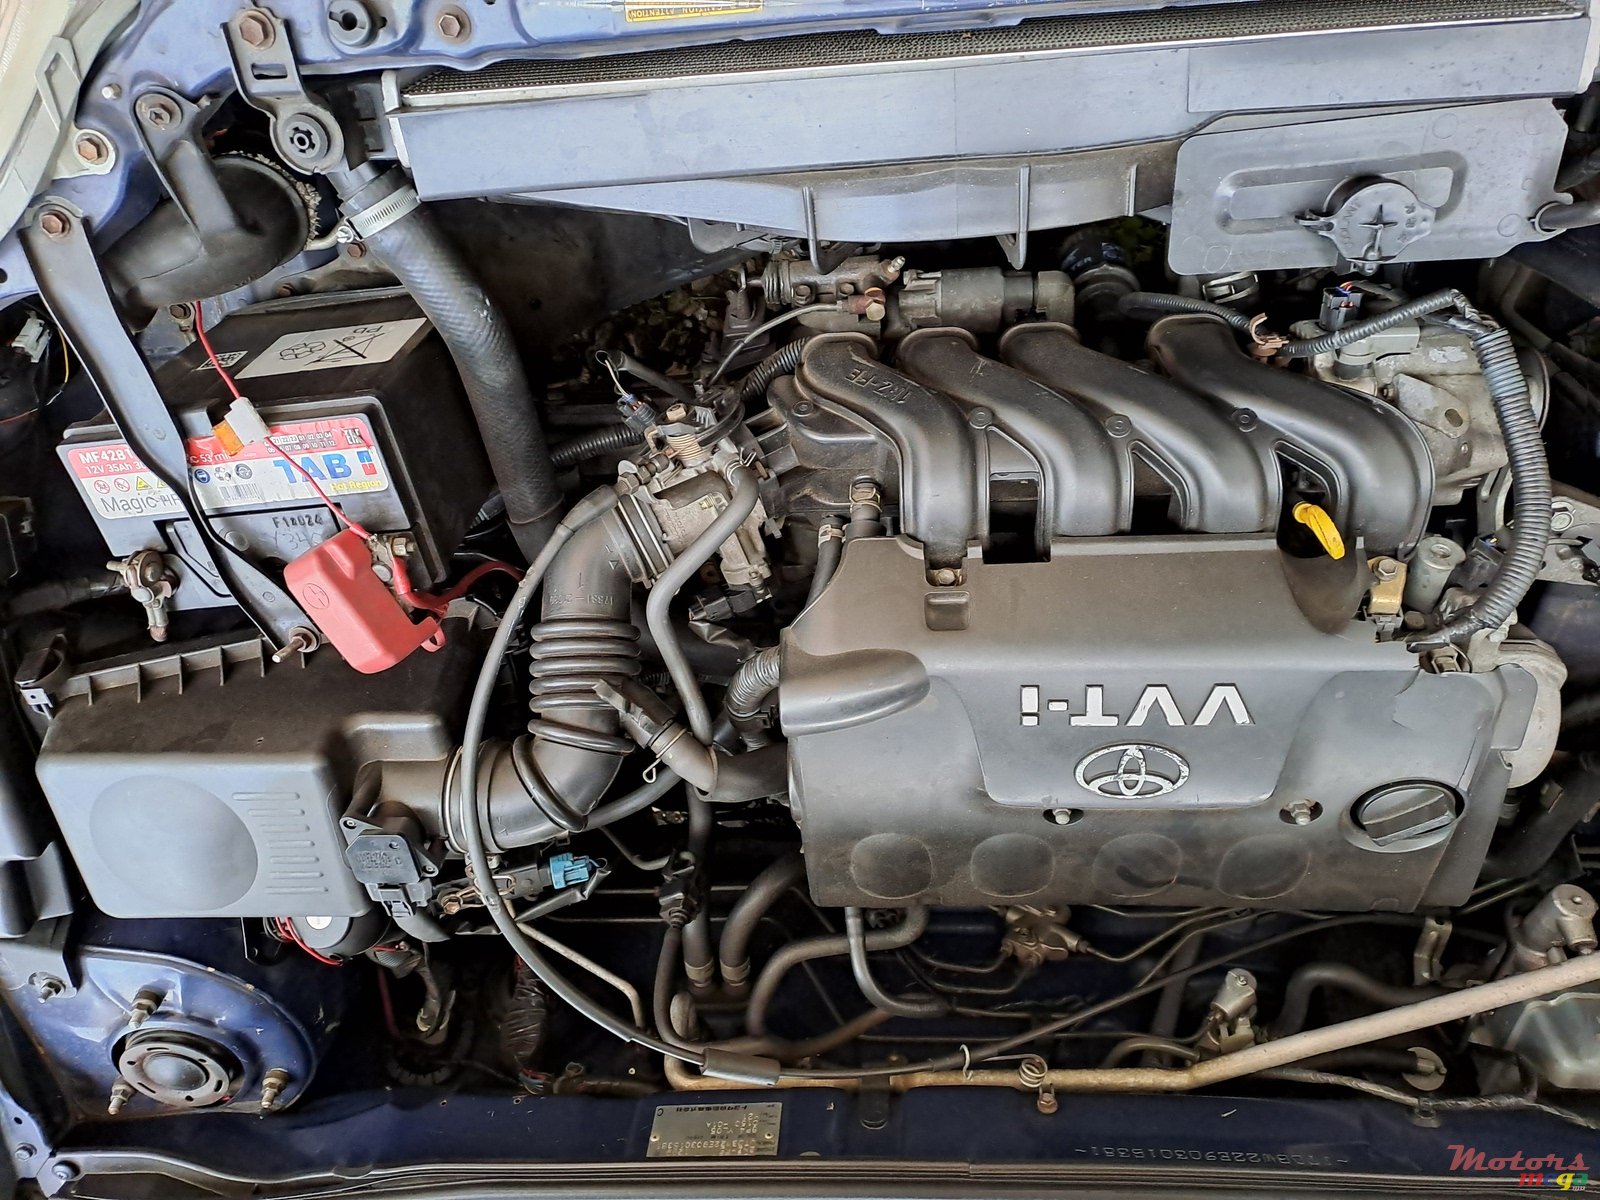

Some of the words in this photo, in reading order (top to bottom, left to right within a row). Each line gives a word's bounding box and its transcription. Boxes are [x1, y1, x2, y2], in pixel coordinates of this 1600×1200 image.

[85, 465, 105, 475] 12V
[107, 462, 133, 473] 35Ah
[273, 453, 352, 484] TAB
[330, 483, 347, 492] Hot
[350, 480, 382, 491] Region
[101, 494, 158, 514] Magic
[1019, 683, 1256, 727] VVT-i
